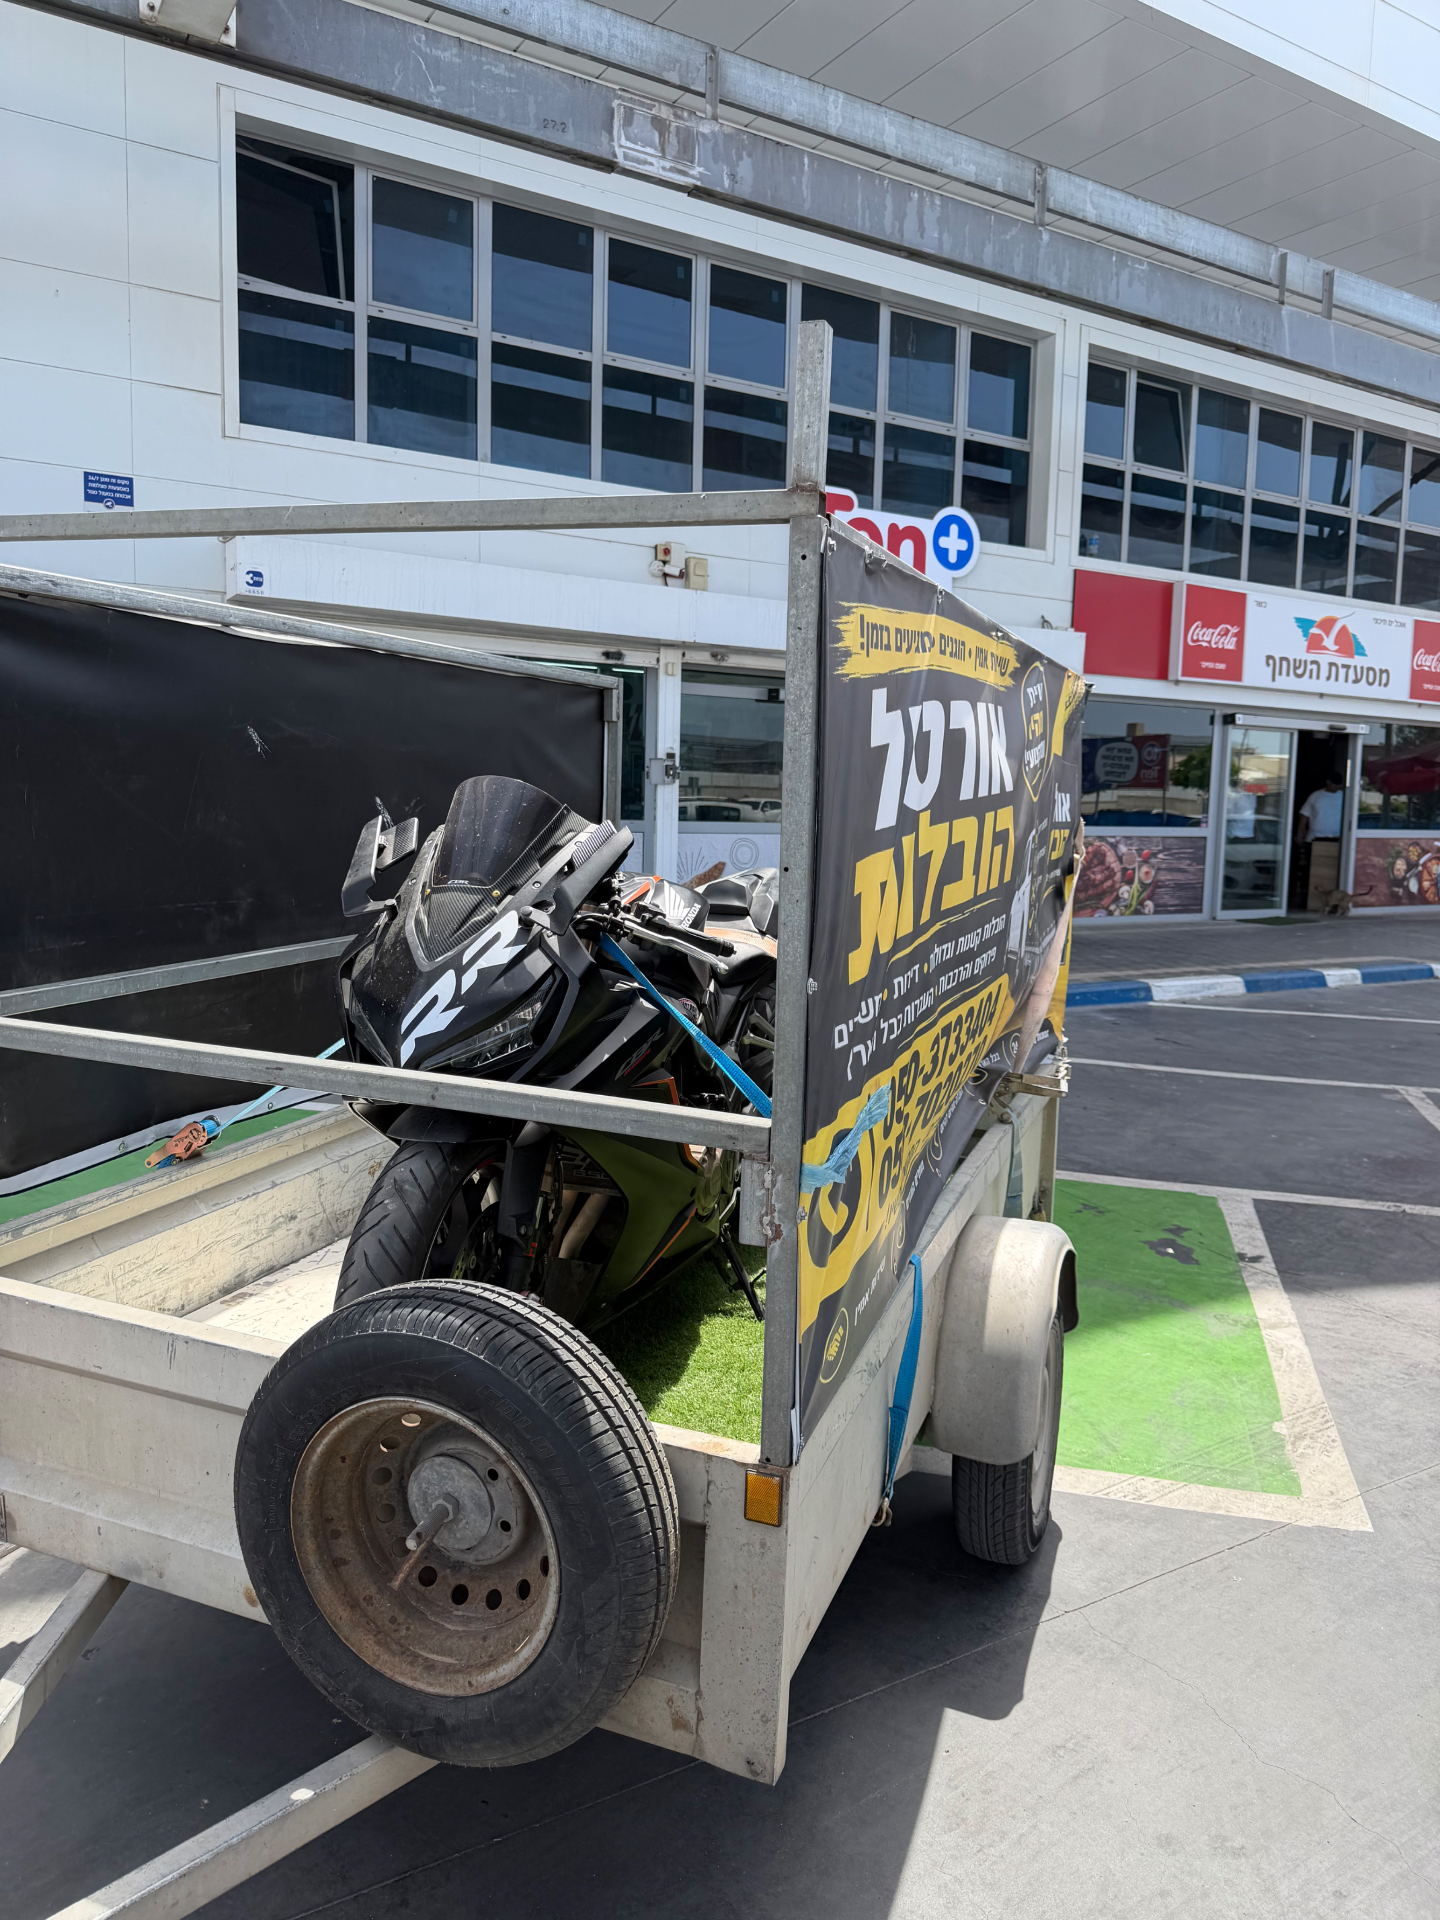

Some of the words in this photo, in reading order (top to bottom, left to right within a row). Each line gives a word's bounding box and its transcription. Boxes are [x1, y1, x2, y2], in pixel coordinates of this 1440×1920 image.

[542, 118, 567, 133] 27.2
[1254, 600, 1267, 608] כשר
[860, 614, 892, 658] בזמן!
[939, 633, 966, 662] הוגנים
[974, 645, 989, 672] אמין
[1265, 654, 1322, 683] השחף
[1326, 661, 1391, 688] מסעדת
[871, 687, 1013, 831] אורטל
[848, 805, 1014, 986] הובלות
[681, 903, 701, 928] HONDA
[983, 914, 1006, 941] הובלות
[956, 932, 982, 955] קטנות
[401, 910, 527, 1068] RR
[939, 961, 972, 995] והרכבות
[882, 982, 1003, 1141] 050-3733404
